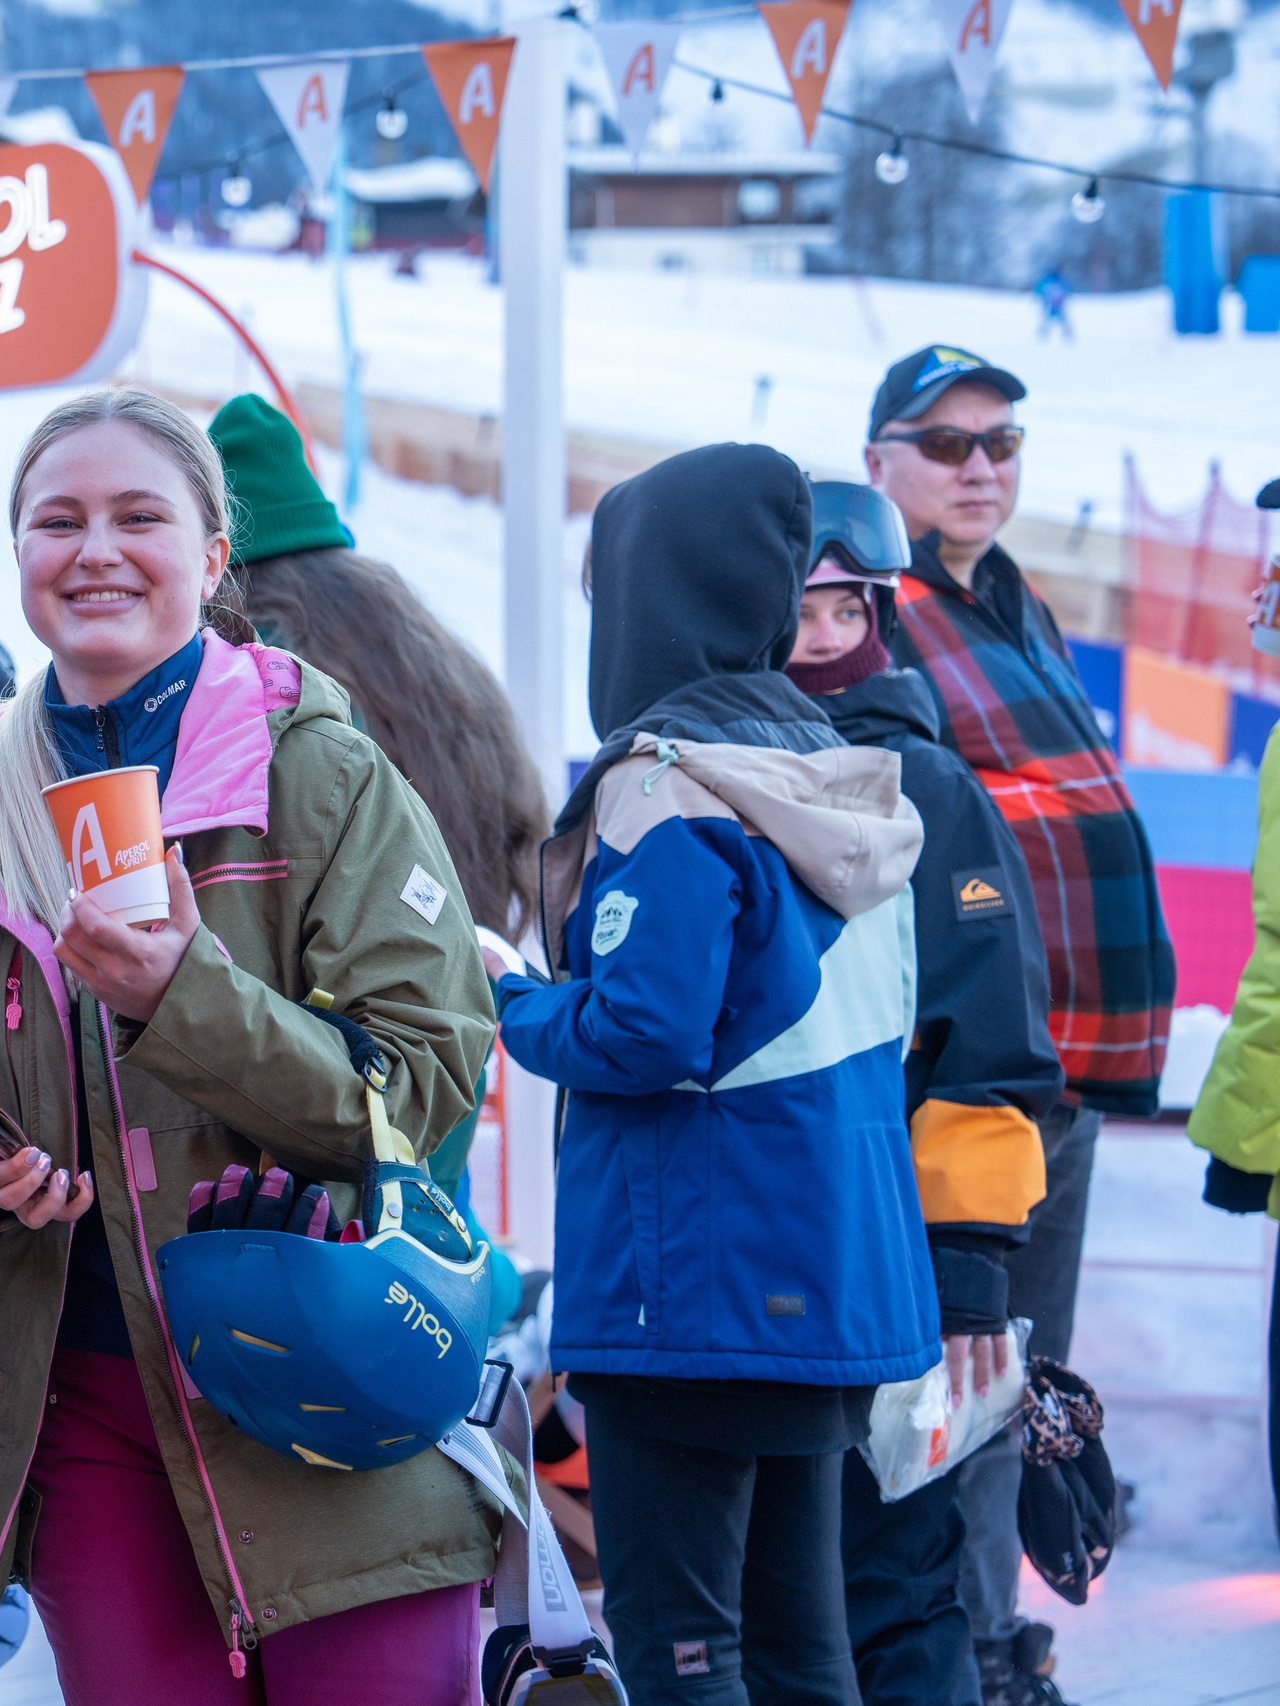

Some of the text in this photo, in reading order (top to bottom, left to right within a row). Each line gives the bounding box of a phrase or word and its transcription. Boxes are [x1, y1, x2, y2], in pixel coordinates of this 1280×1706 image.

[791, 18, 827, 79] A
[958, 0, 991, 53] A
[459, 63, 494, 123] A
[622, 43, 654, 97] A
[120, 90, 156, 147] A
[297, 75, 328, 129] A
[157, 679, 187, 705] COLMAR
[72, 802, 113, 892] A
[114, 840, 150, 866] APEROL
[430, 1186, 452, 1211] bollé
[384, 1280, 453, 1360] bollé
